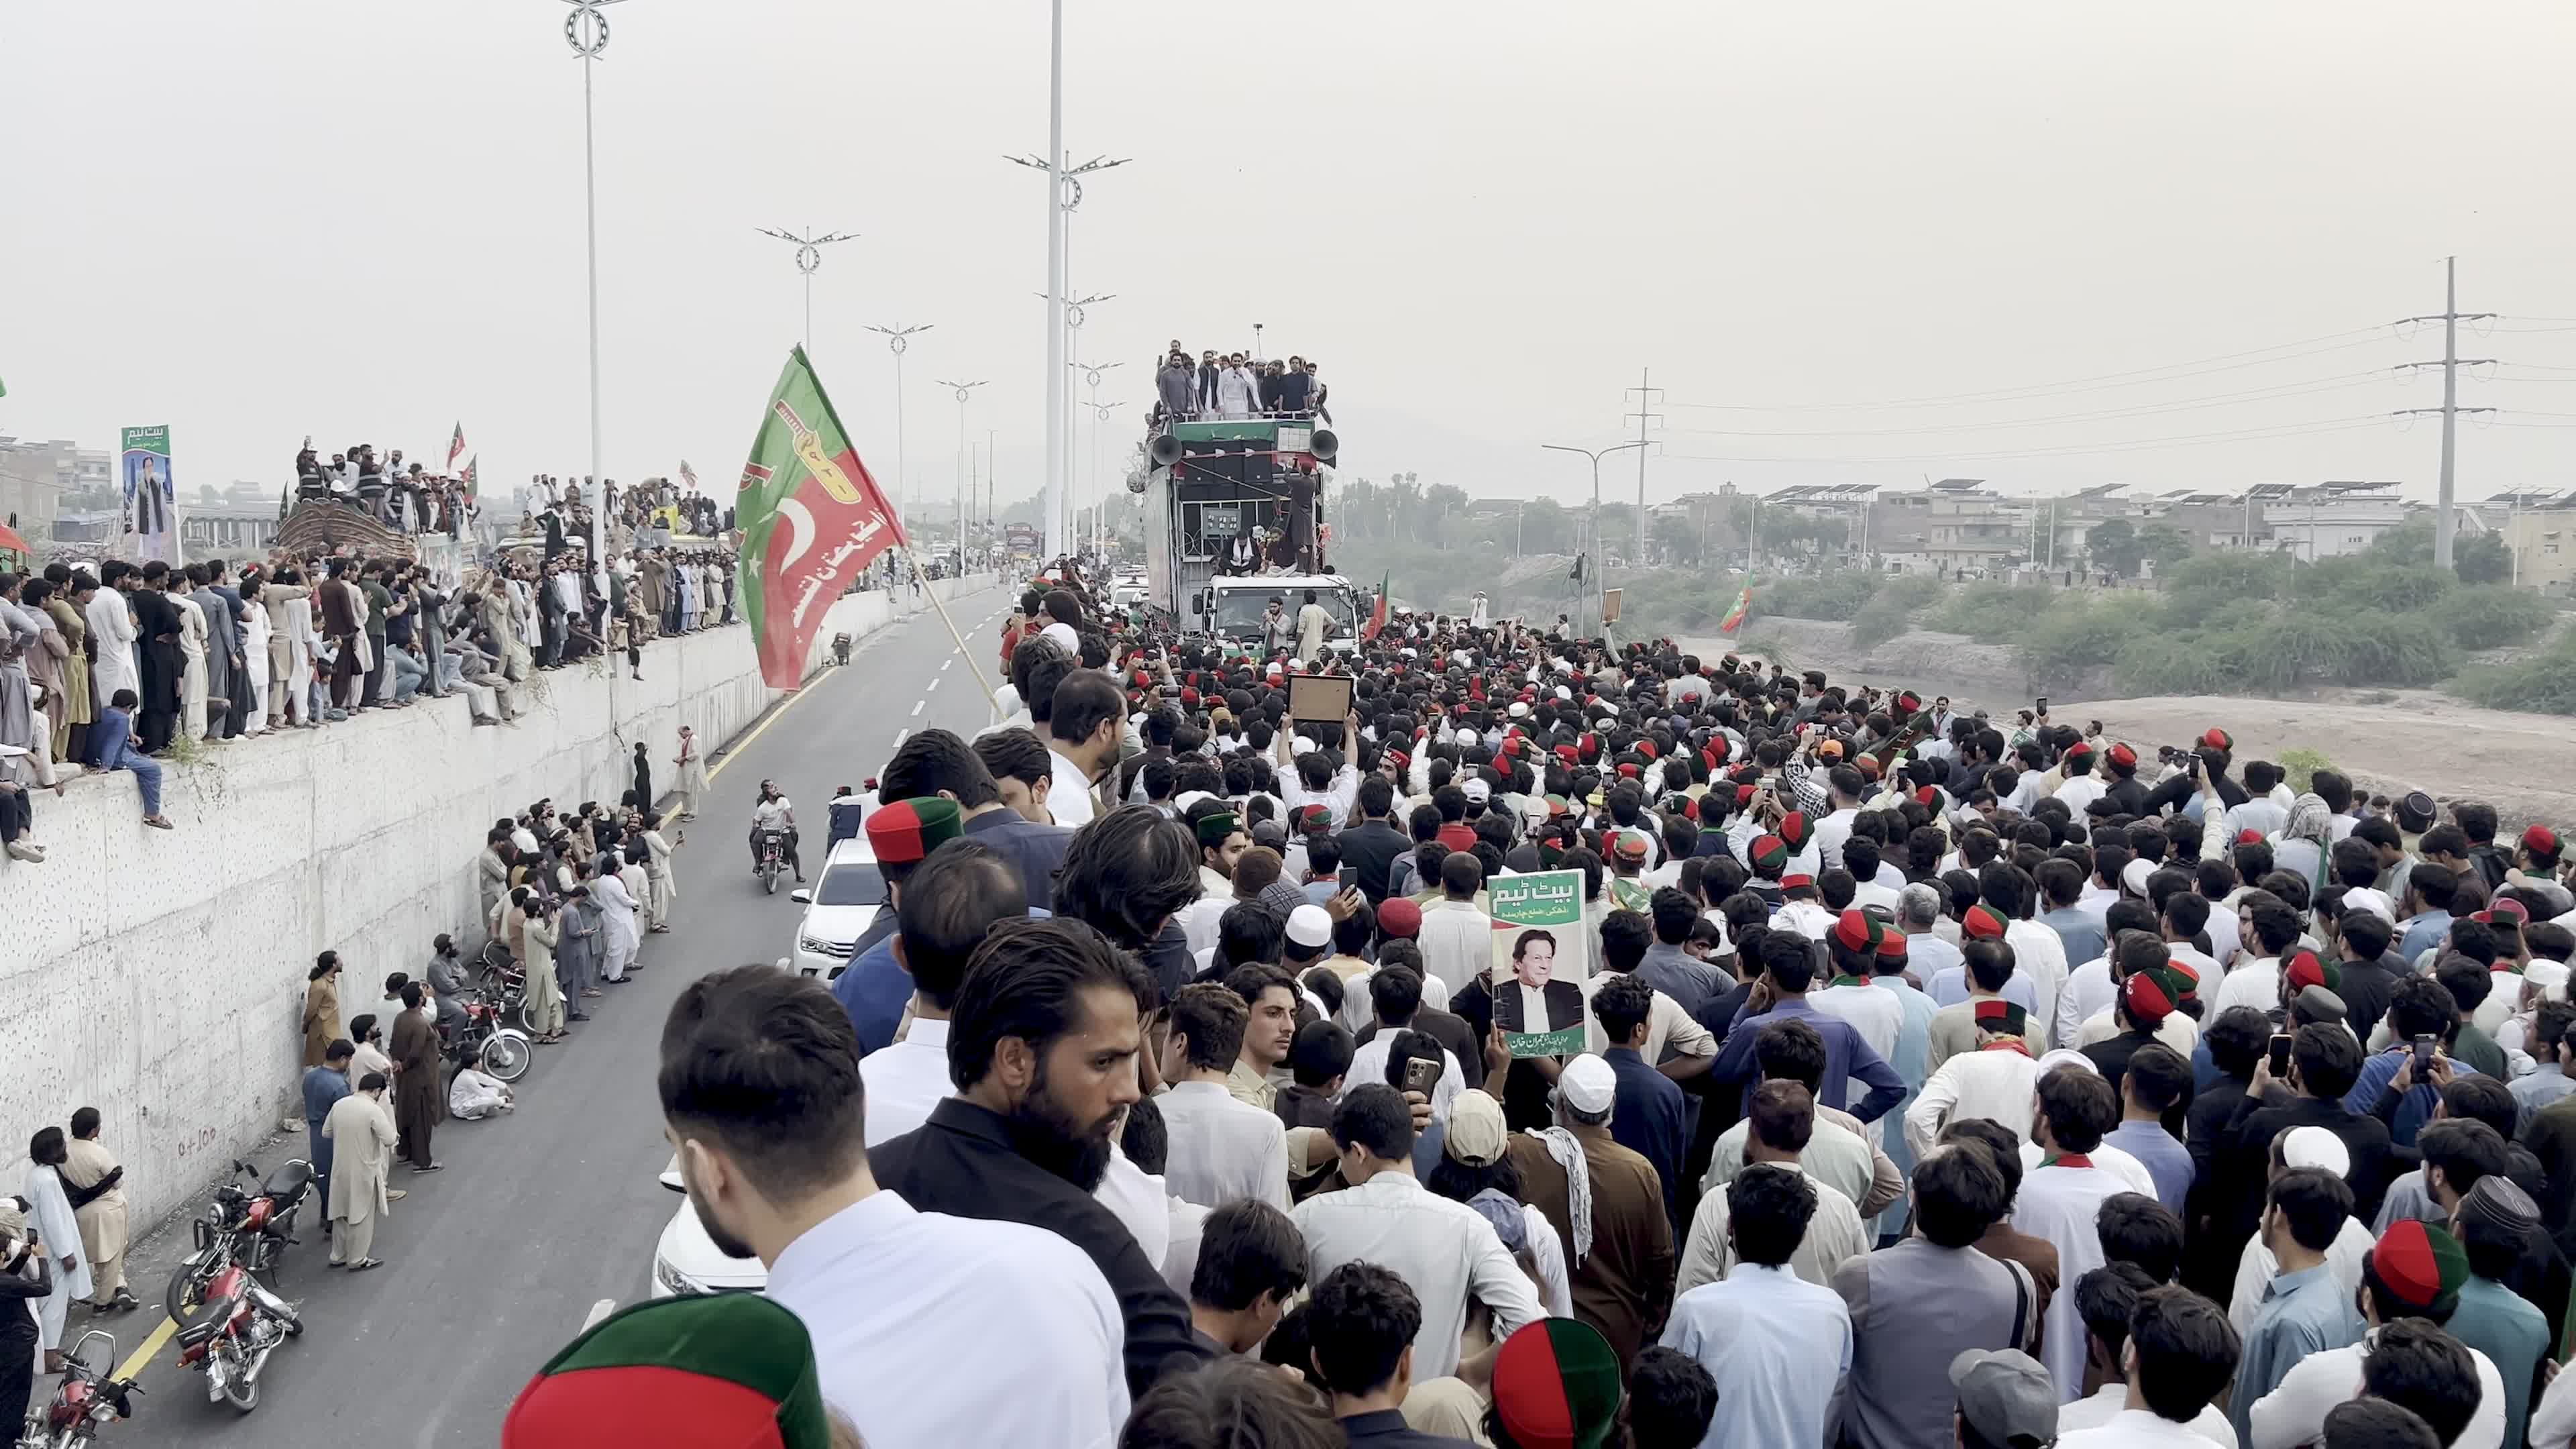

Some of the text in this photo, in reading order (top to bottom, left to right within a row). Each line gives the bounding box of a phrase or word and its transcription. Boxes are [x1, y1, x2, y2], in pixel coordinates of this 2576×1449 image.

[1492, 879, 1573, 914] بیٹ ٹیم
[1509, 1036, 1525, 1049] خان
